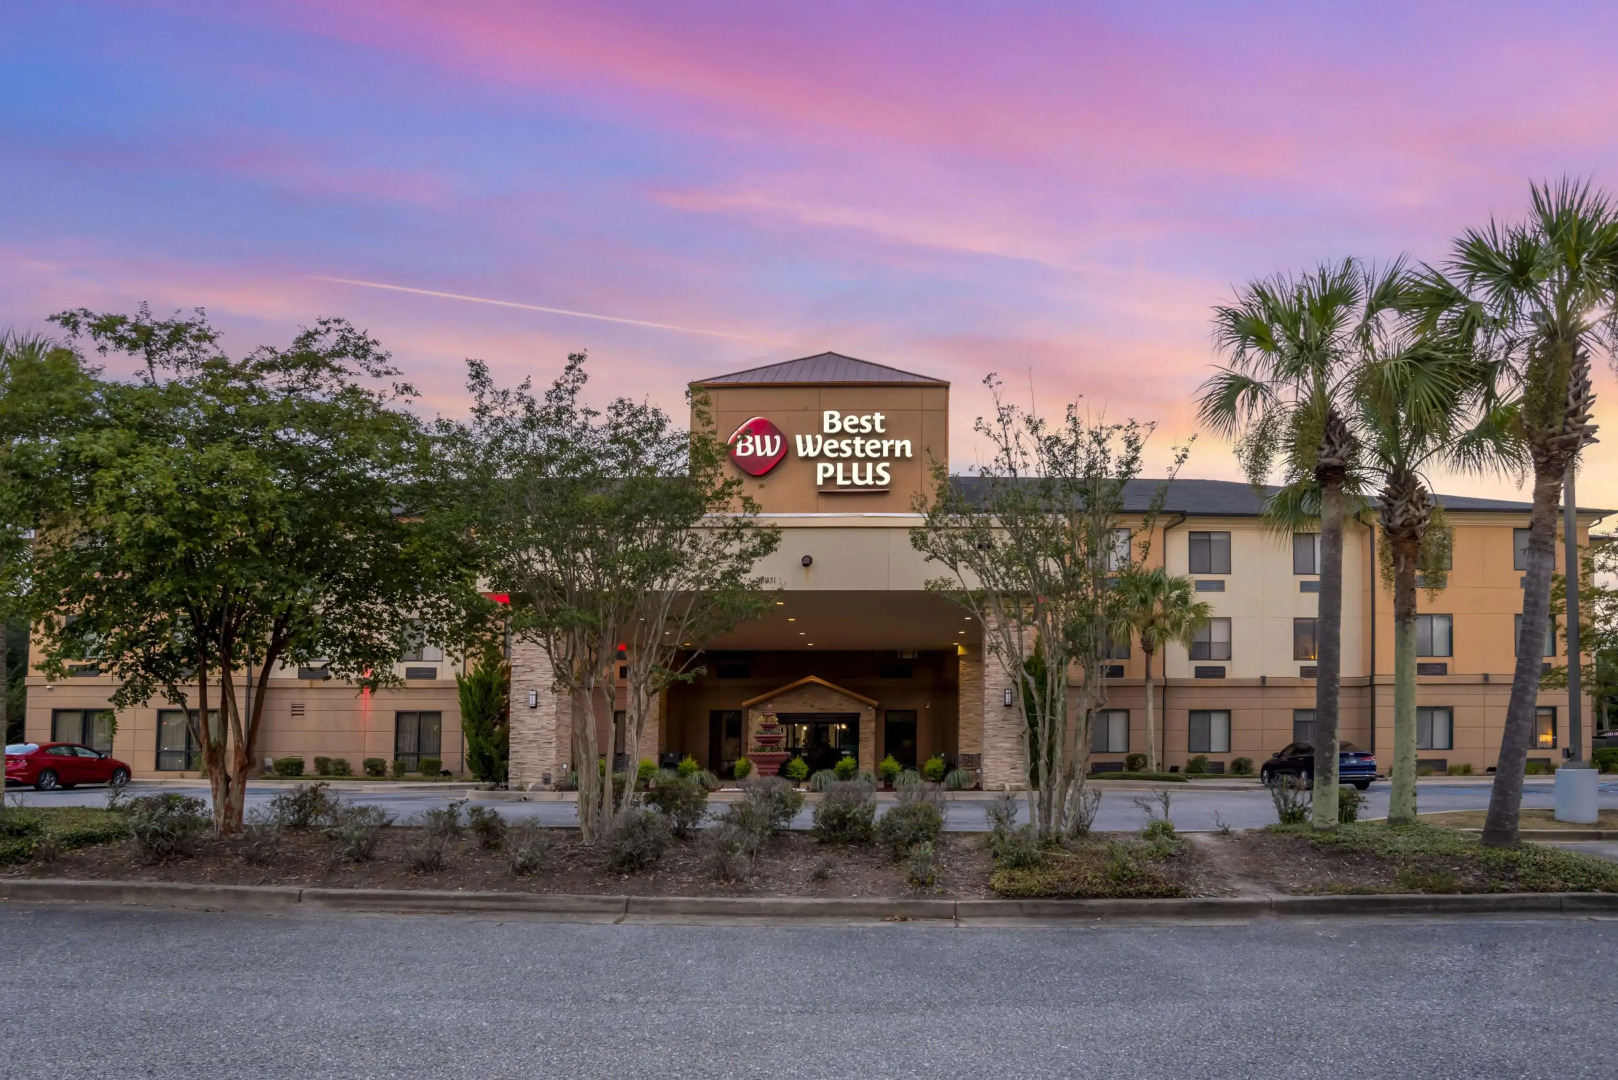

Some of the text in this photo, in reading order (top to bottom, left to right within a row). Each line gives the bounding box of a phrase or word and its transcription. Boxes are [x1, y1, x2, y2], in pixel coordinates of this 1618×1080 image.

[823, 410, 885, 434] Best
[736, 434, 781, 457] BW
[795, 434, 913, 458] Western
[816, 462, 891, 486] PLUS
